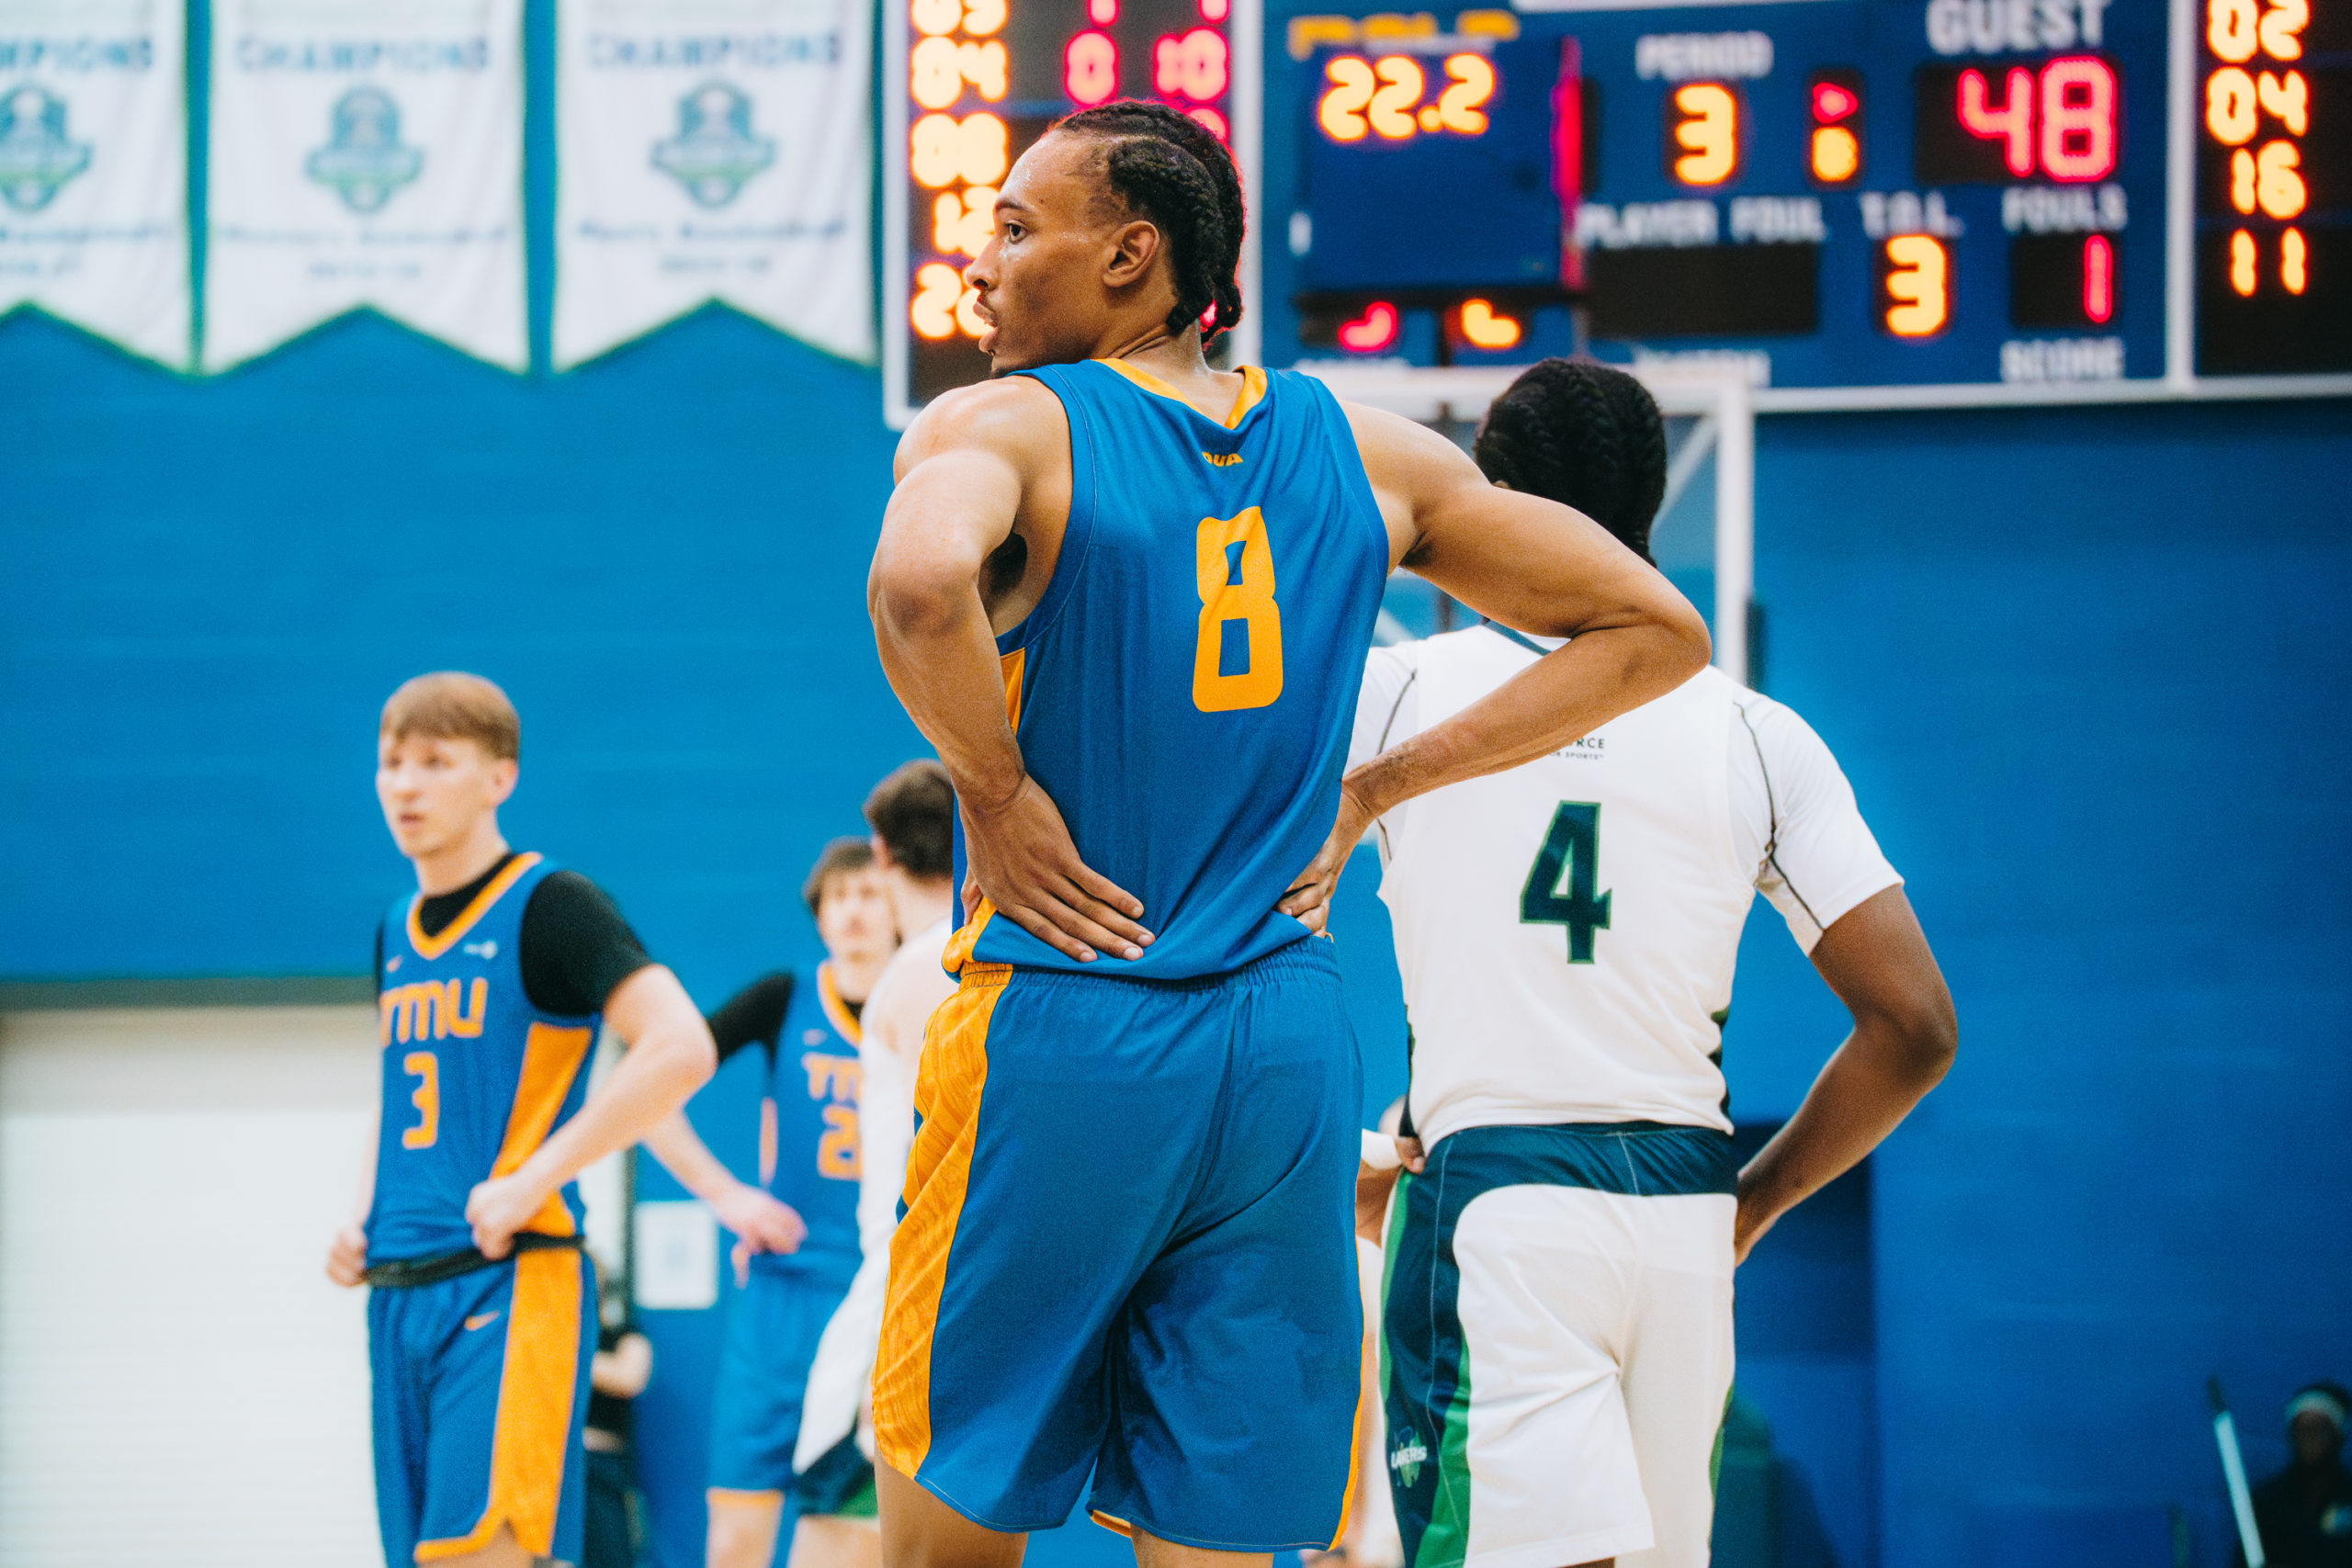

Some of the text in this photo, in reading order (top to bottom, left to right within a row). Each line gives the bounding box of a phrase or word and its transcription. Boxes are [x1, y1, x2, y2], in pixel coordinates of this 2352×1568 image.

[1635, 32, 1774, 80] PERIOD
[1925, 0, 2112, 55] GUEST
[2207, 0, 2310, 62] 02
[910, 35, 1009, 110] 04
[1318, 51, 1496, 141] 22.2
[2206, 66, 2309, 146] 04
[1675, 83, 1737, 186] 3
[1957, 55, 2116, 182] 48
[2000, 186, 2128, 234] FOULS
[2230, 140, 2309, 220] 16
[1577, 196, 1826, 248] PLAYER FOUL
[2230, 227, 2307, 297] 11
[1886, 234, 1948, 337] 3
[2084, 234, 2112, 323] 1
[1193, 505, 1283, 713] 8
[1520, 799, 1612, 964] 4
[379, 976, 489, 1048] TMU
[402, 1051, 440, 1150] 3
